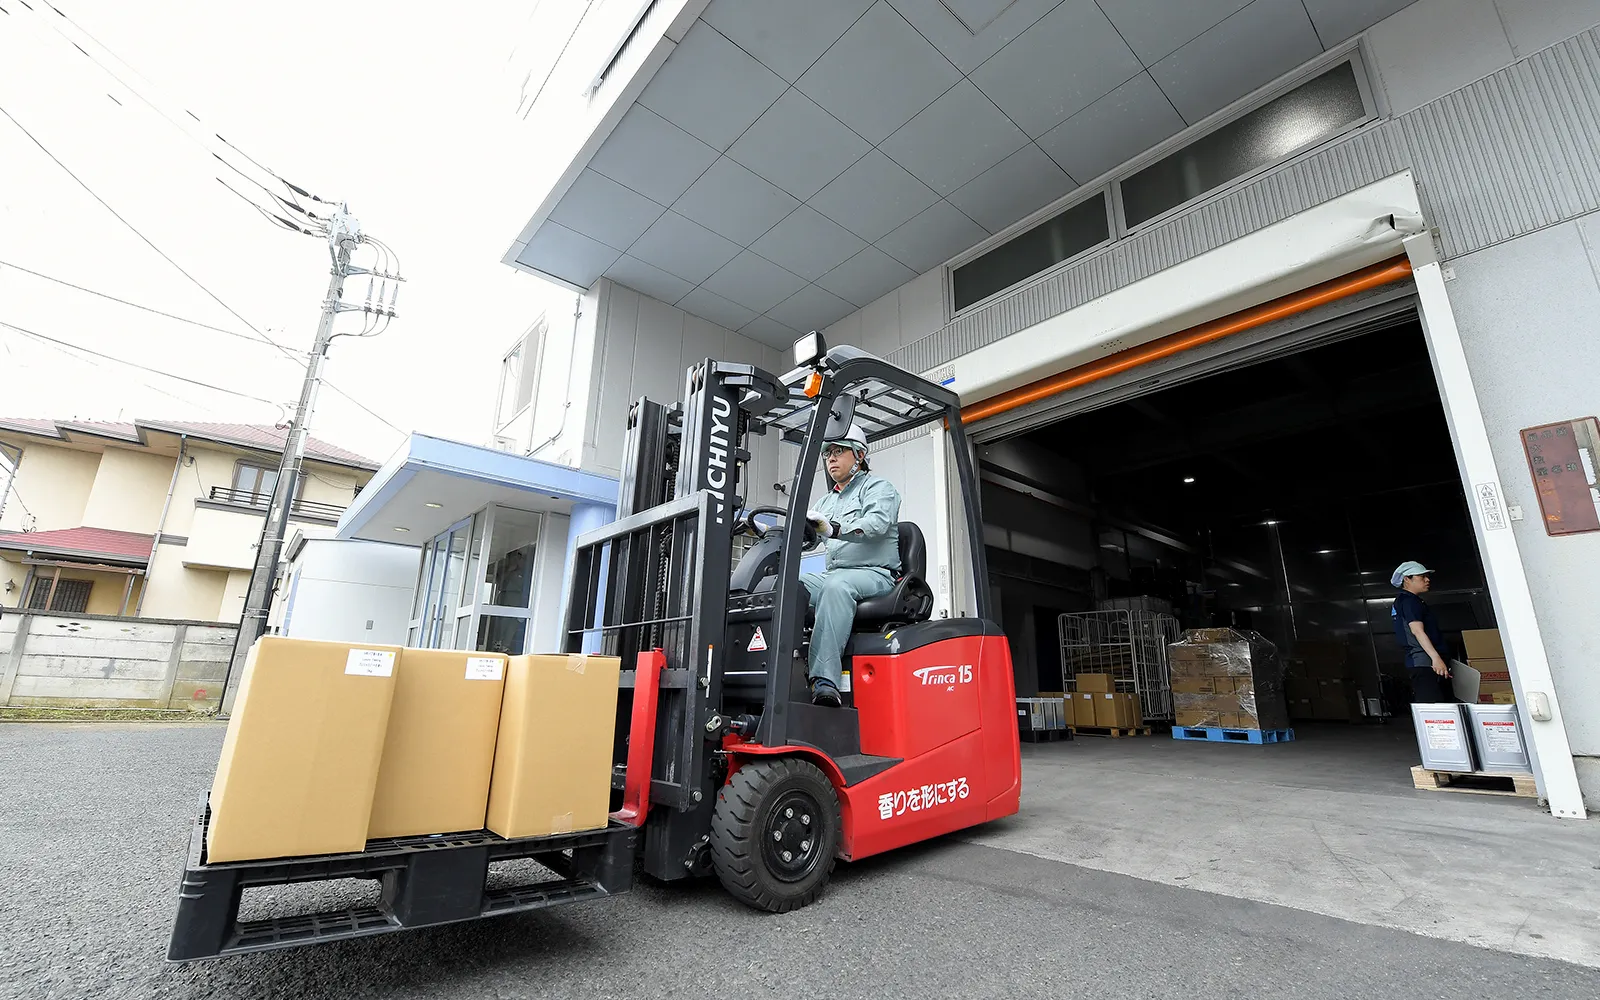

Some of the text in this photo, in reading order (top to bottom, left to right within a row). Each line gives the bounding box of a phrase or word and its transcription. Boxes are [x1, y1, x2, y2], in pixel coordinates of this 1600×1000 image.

[912, 664, 973, 685] Trinca 15
[878, 777, 970, 820] 香りを形にする
